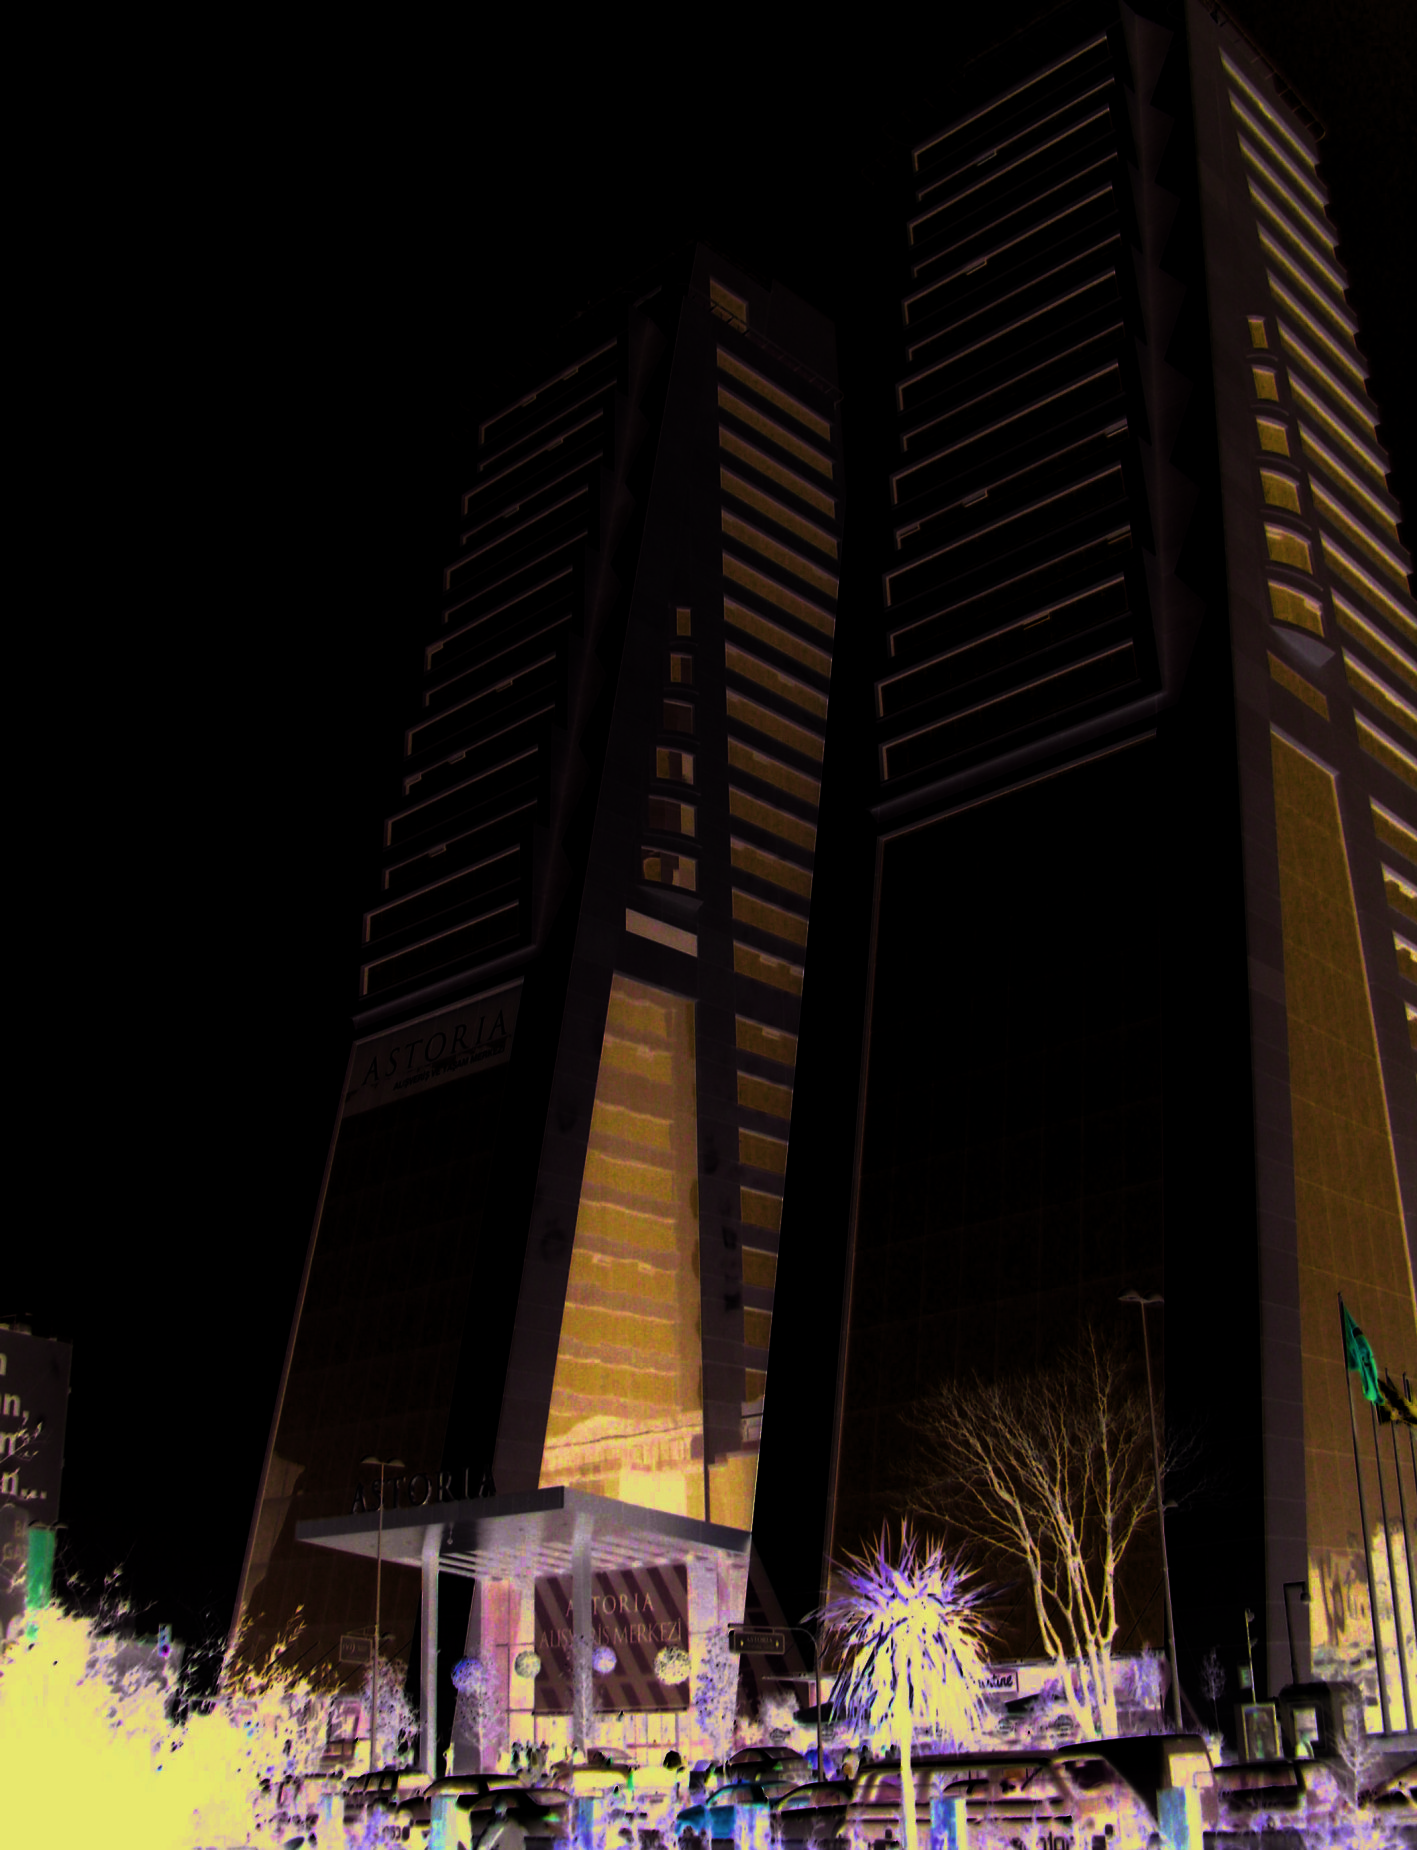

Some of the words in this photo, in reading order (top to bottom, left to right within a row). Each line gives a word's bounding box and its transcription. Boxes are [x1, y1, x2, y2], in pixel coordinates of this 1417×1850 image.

[362, 1009, 507, 1086] ASTORIA
[351, 1464, 497, 1514] ASTORIA
[565, 1592, 655, 1616] ATORIA
[613, 1617, 682, 1645] MERKEZİ
